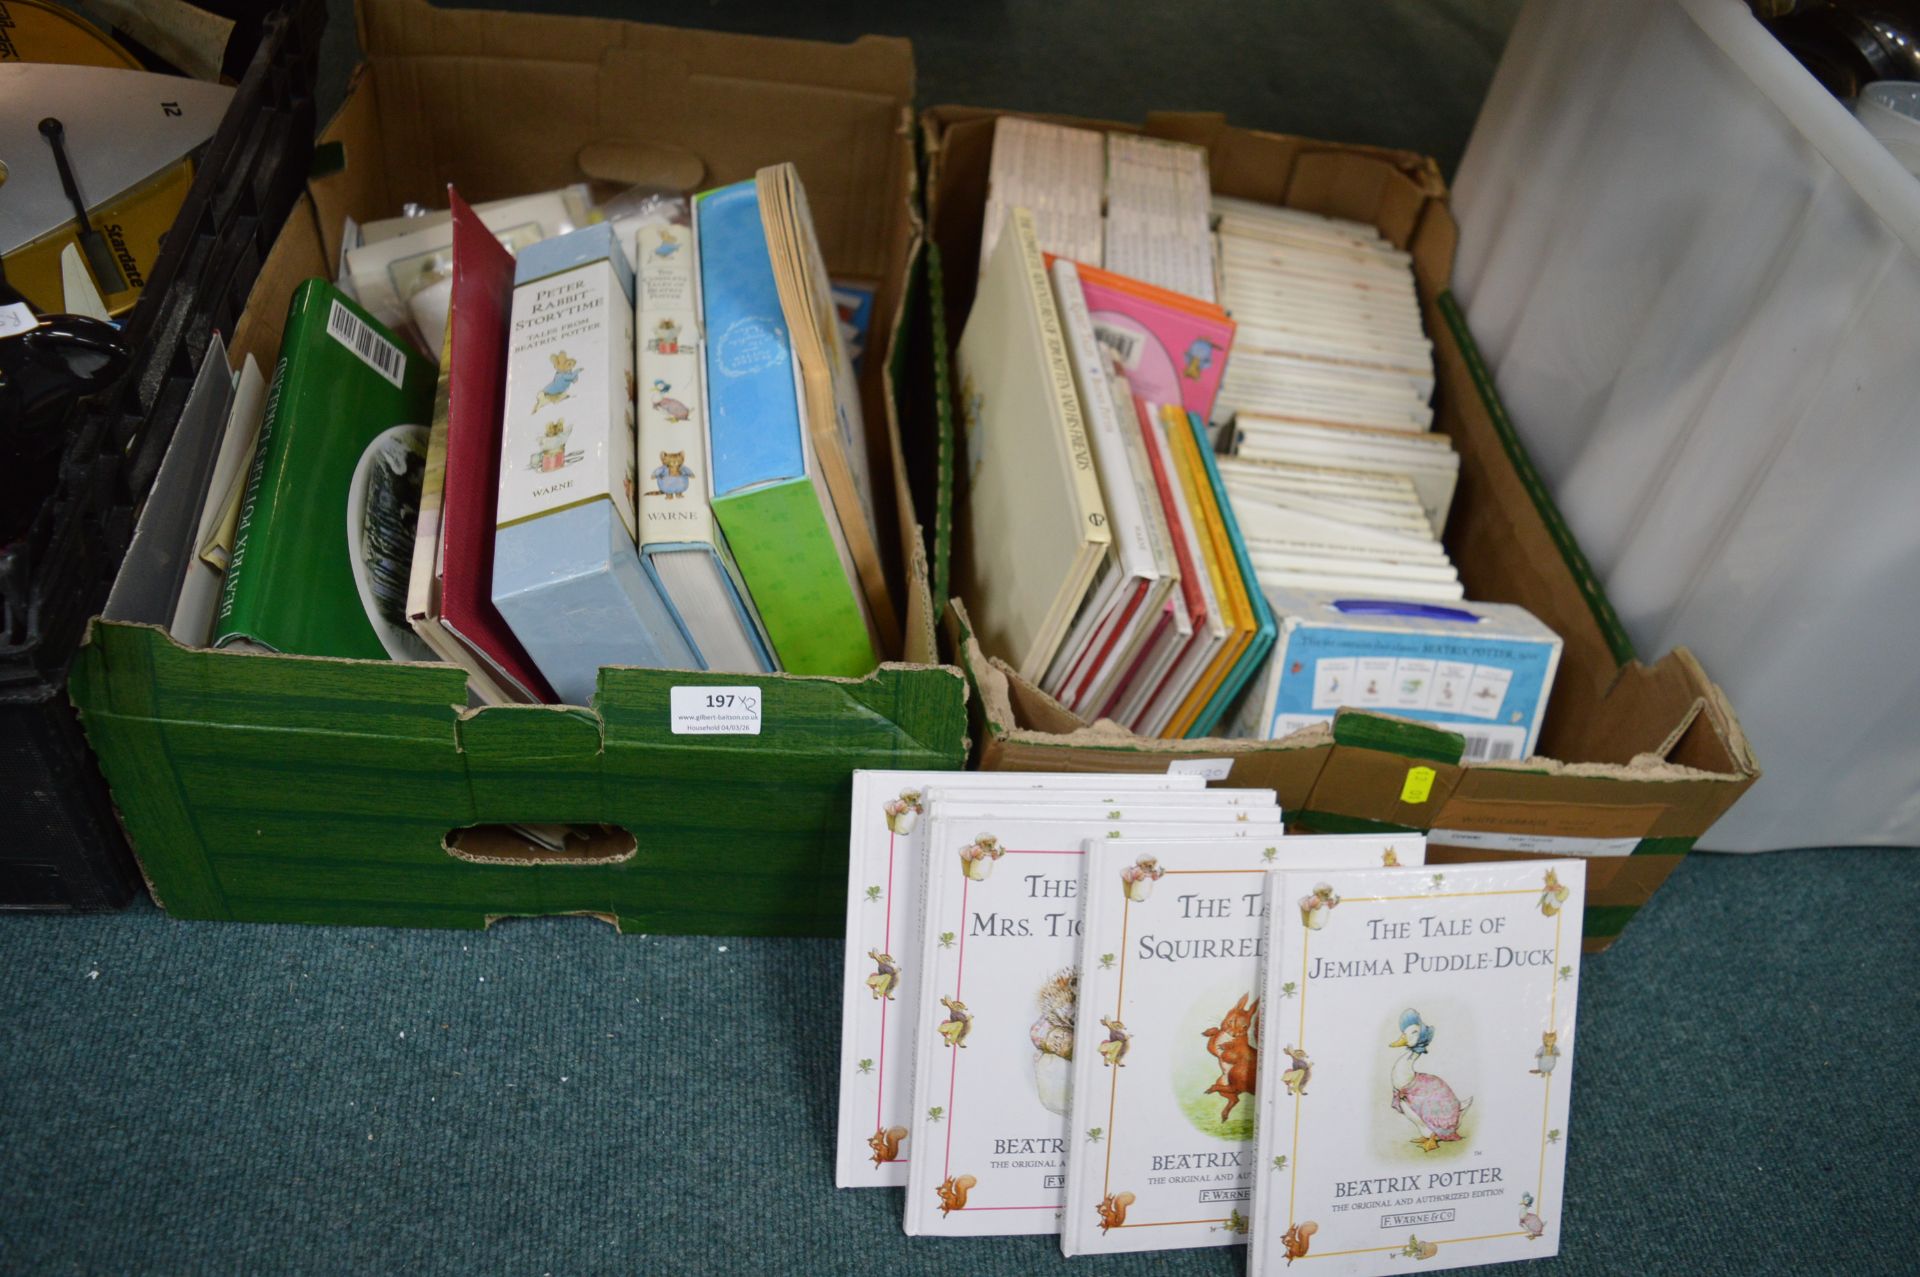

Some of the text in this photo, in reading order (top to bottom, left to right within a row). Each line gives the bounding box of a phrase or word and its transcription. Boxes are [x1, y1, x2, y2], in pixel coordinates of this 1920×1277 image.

[161, 101, 182, 118] 12
[104, 223, 145, 289] Stardate
[536, 279, 586, 302] PETER
[515, 297, 605, 332] STORYTIME
[531, 291, 587, 315] RABBIT
[514, 322, 601, 354] BEATRIX POTTER
[526, 327, 559, 342] TALES
[220, 529, 249, 619] BEATRIX
[260, 356, 289, 441] LAKELAND
[532, 479, 575, 498] WARNE
[647, 511, 699, 522] WARNE
[706, 694, 735, 708] 197
[1023, 873, 1078, 898] THE
[1177, 894, 1232, 919] THE
[969, 912, 1034, 937] MRS.
[1366, 915, 1507, 941] THE TALE OF
[1308, 945, 1555, 980] JEMIMA PUDDLE-DUCK
[990, 1160, 1009, 1169] THE
[1011, 1159, 1057, 1168] ORIGINAL
[1151, 1151, 1244, 1171] BEATRIX
[1148, 1176, 1167, 1185] THE
[1168, 1174, 1211, 1184] ORIGINAL
[1214, 1173, 1235, 1181] AND
[1335, 1167, 1504, 1198] BEATRIX POTTER
[1331, 1187, 1505, 1213] THE ORIGINAL AND AUTHORIZED EDITION
[1393, 1213, 1429, 1225] WARNE
